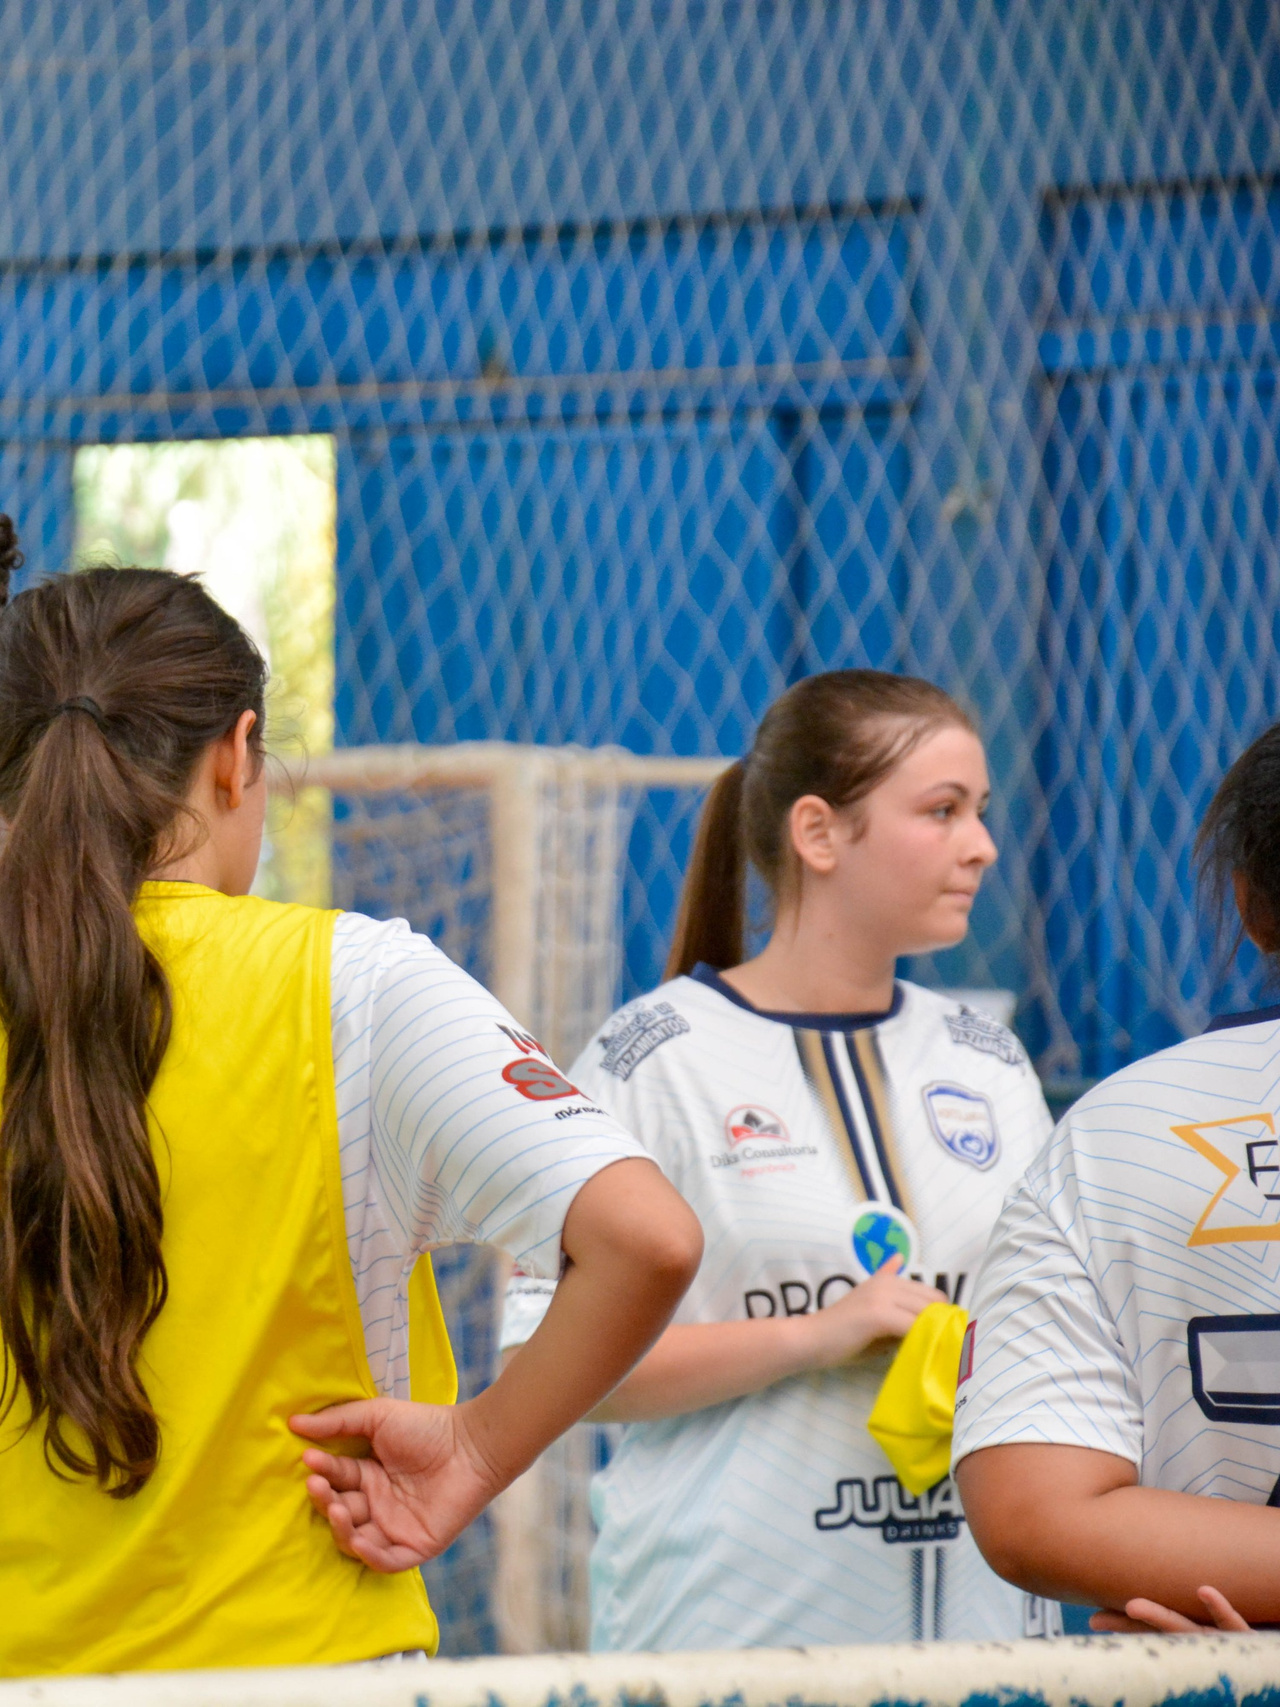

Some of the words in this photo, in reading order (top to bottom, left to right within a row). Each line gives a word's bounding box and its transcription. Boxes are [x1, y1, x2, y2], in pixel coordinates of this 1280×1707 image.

[612, 1014, 691, 1081] VAZAMENTOS
[741, 1144, 818, 1160] Consultoria
[885, 1521, 958, 1540] DRINKS
